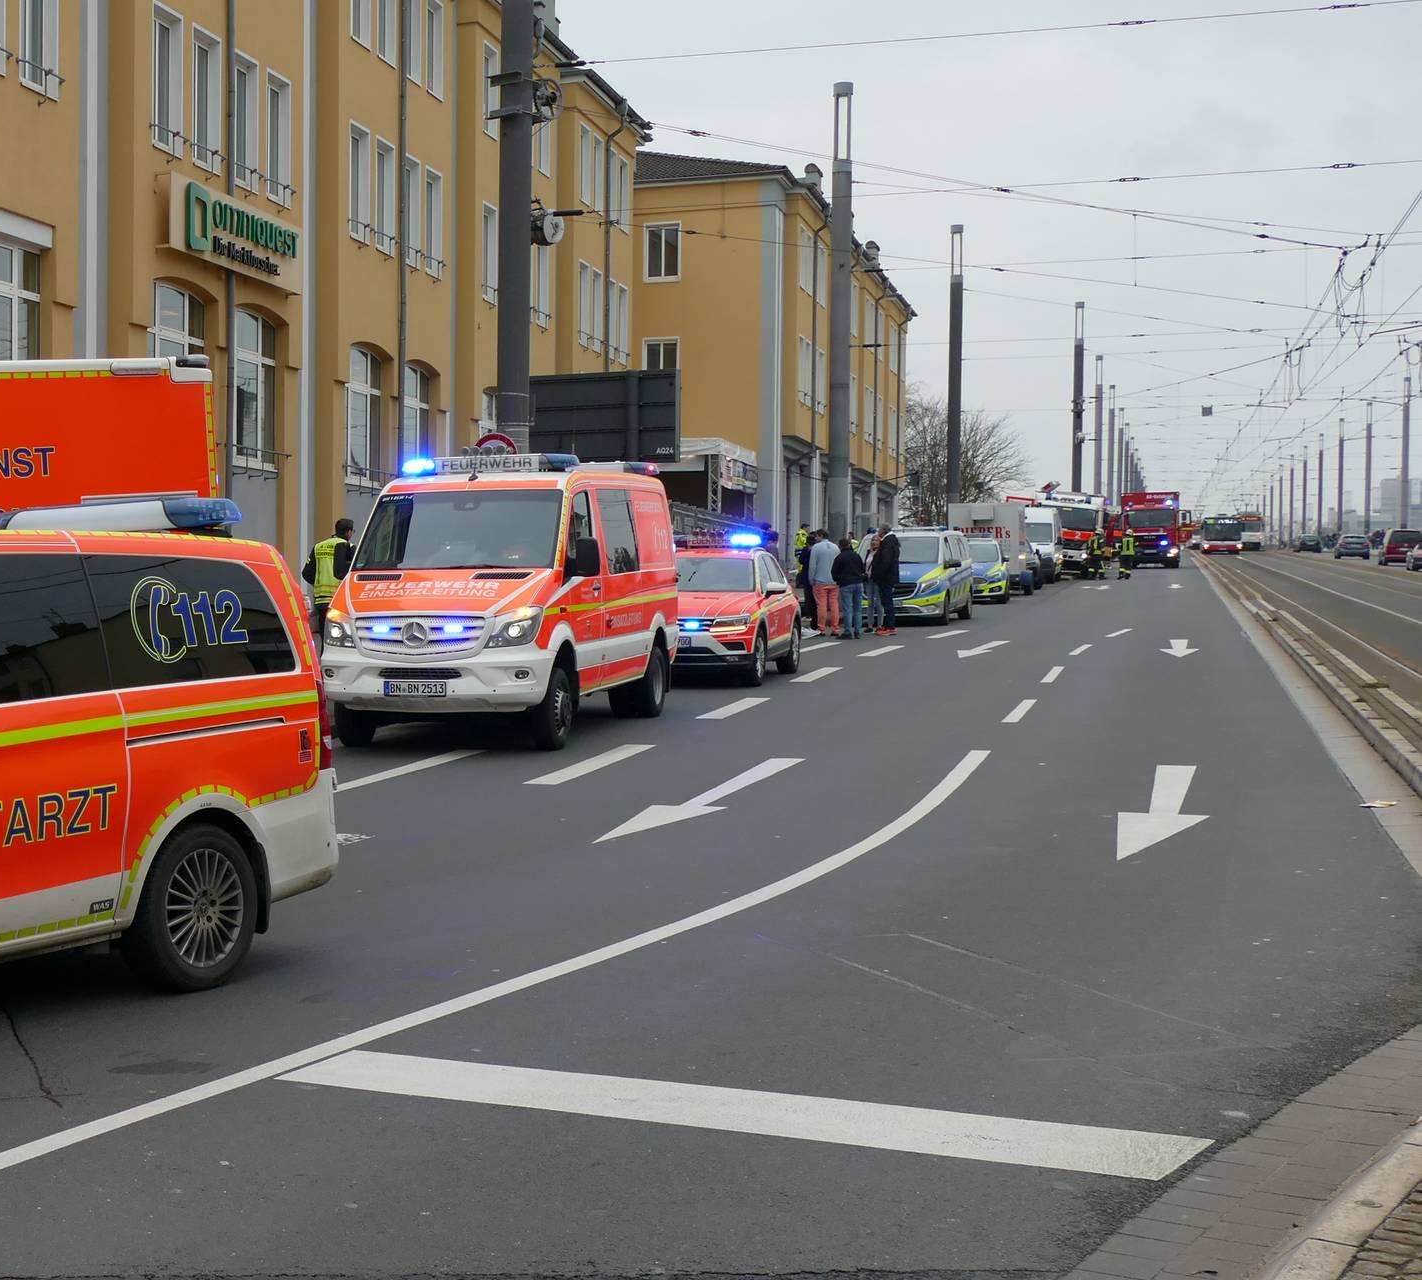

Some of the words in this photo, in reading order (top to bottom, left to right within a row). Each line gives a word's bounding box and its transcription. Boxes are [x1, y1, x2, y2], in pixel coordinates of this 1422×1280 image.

[441, 457, 532, 471] FEUERWEHR
[363, 580, 500, 591] FEUERWEHR
[359, 589, 498, 599] EINSATZLEITUNG
[170, 589, 249, 648] 112
[389, 683, 402, 694] BN
[407, 683, 420, 694] BN
[421, 683, 445, 694] 2513
[93, 901, 110, 911] WAS
